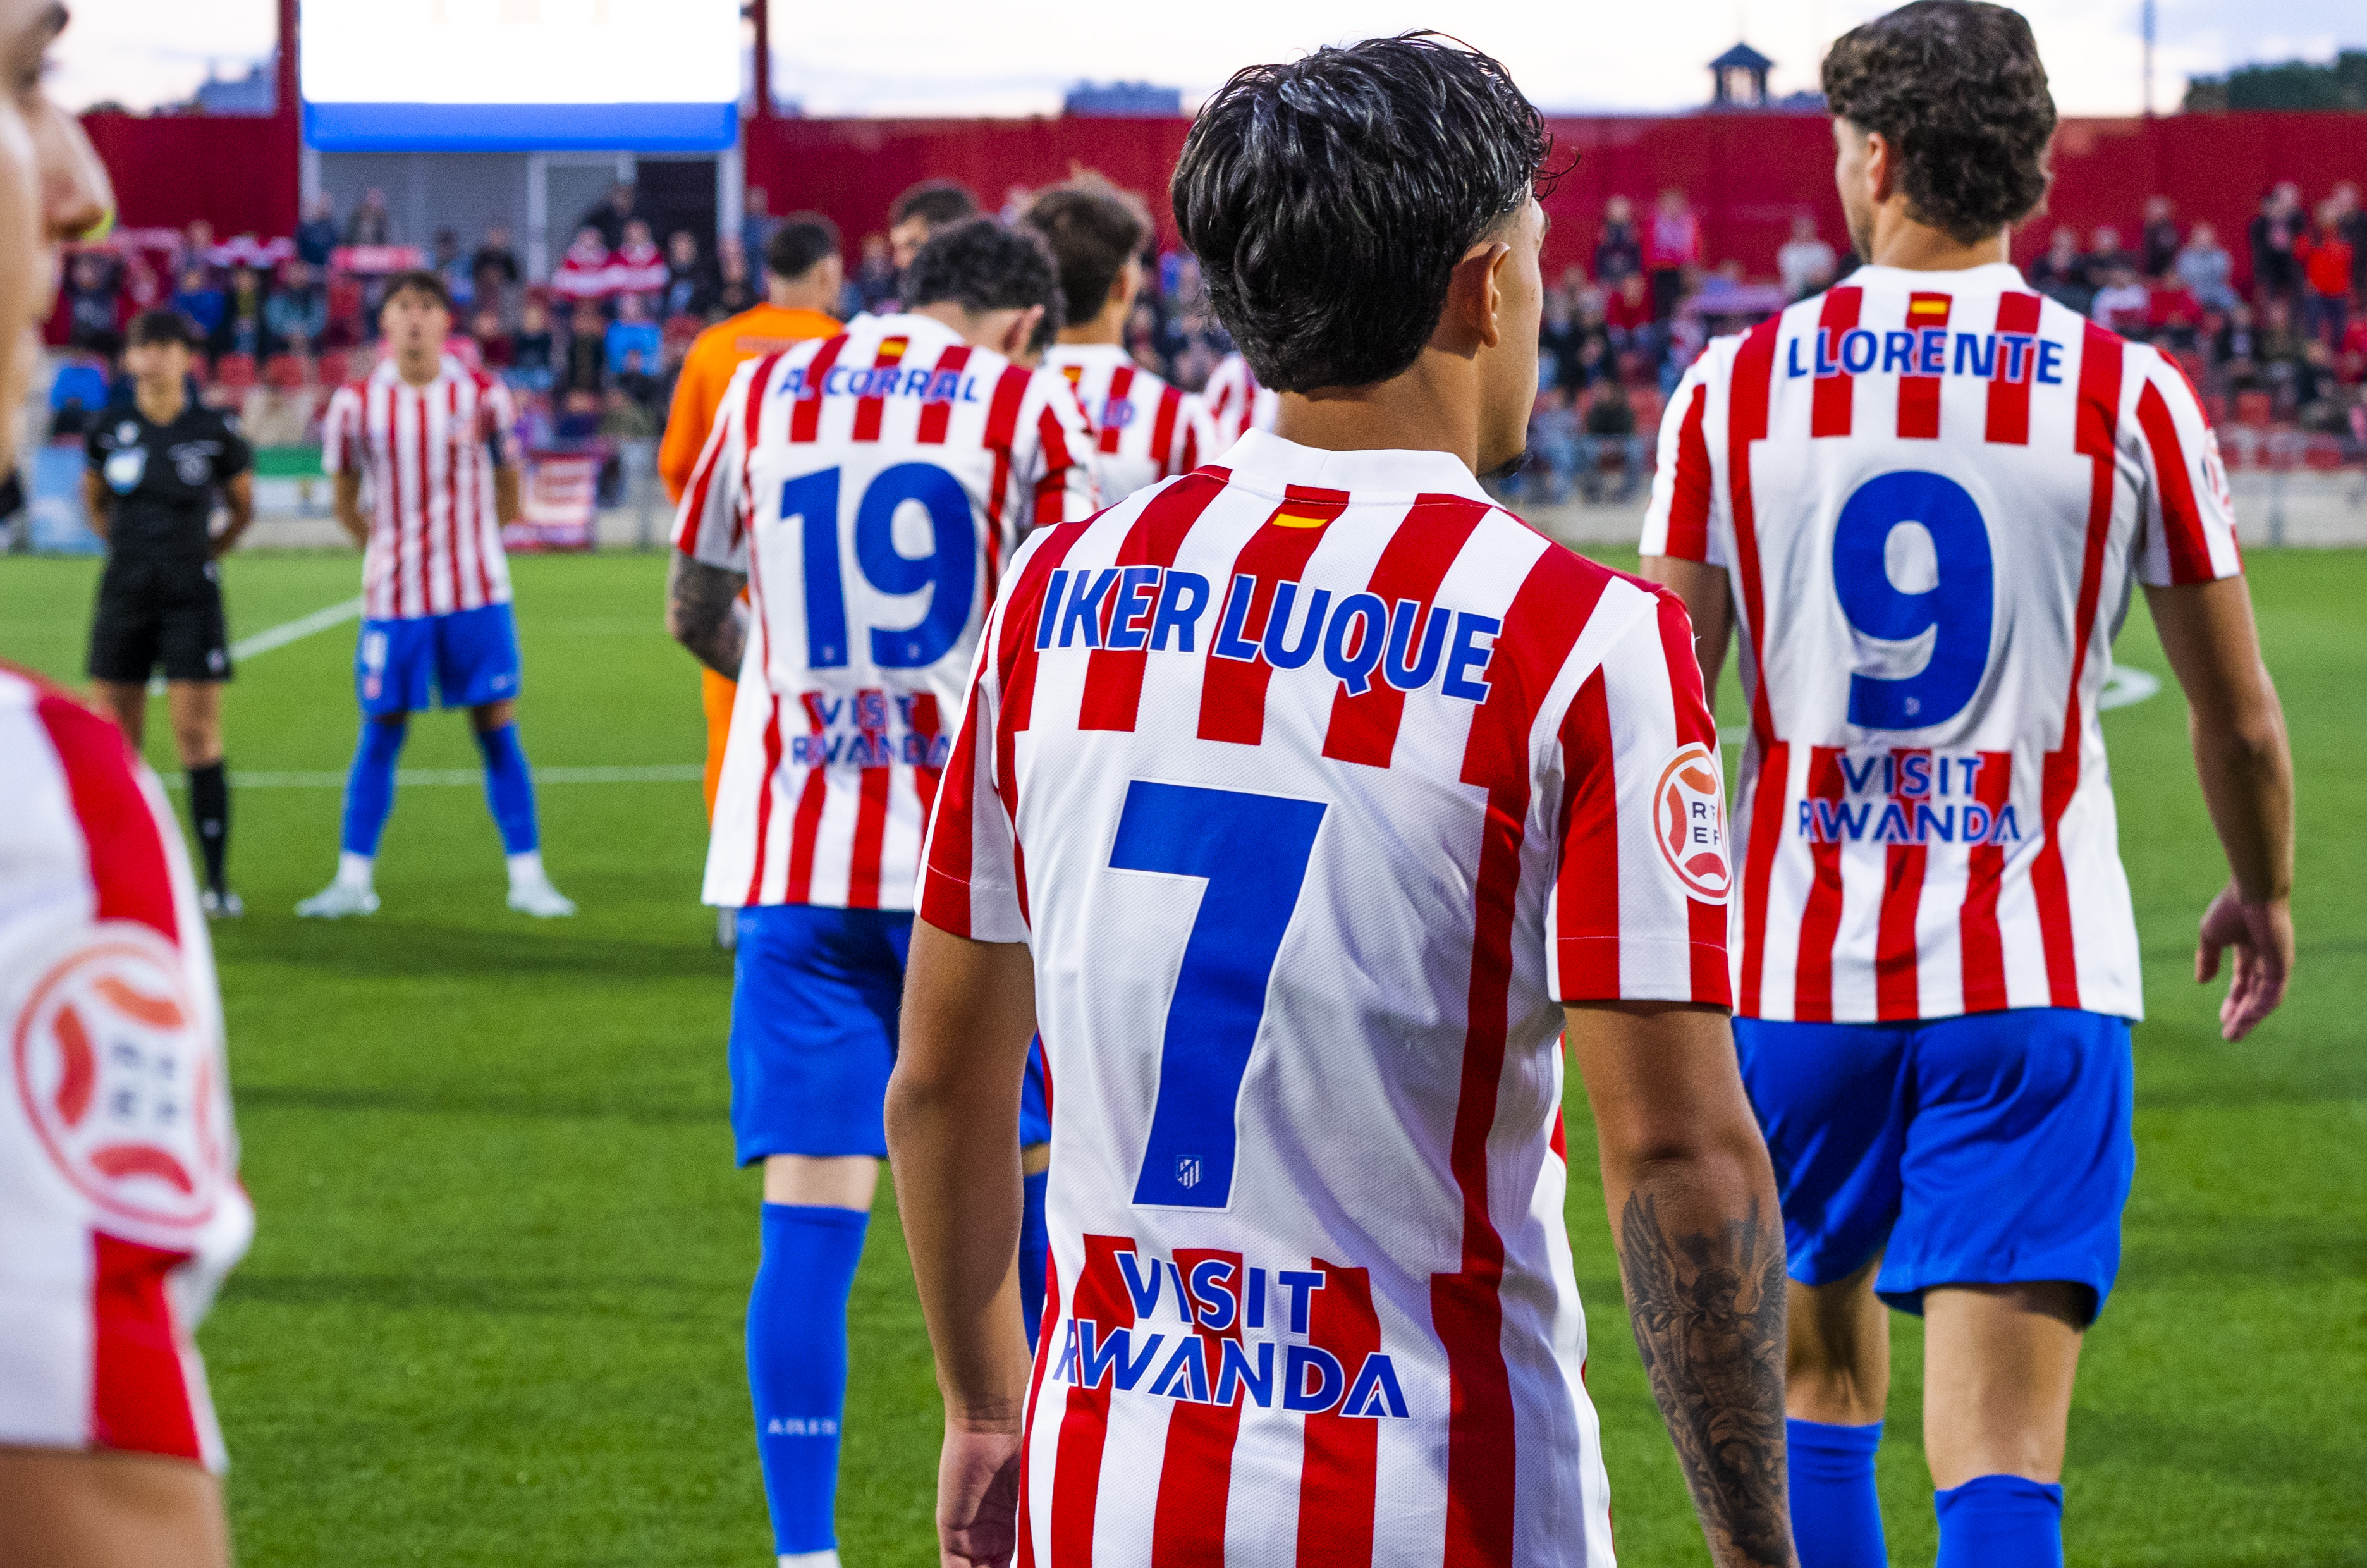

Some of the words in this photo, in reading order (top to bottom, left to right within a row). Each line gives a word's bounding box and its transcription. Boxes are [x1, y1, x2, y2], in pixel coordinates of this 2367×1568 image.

[821, 365, 980, 403] CORRAL
[1787, 326, 2065, 384] LLORENTE
[780, 461, 976, 668] 19
[1832, 469, 1994, 731] 9
[1034, 565, 1211, 653] IKER
[1213, 573, 1503, 704] LUQUE
[1799, 799, 2021, 845] RWANDA
[1838, 753, 1985, 797] VISIT
[1105, 778, 1332, 1211] 7
[1113, 1249, 1326, 1336] VISIT
[1052, 1318, 1410, 1419] RWANDA
